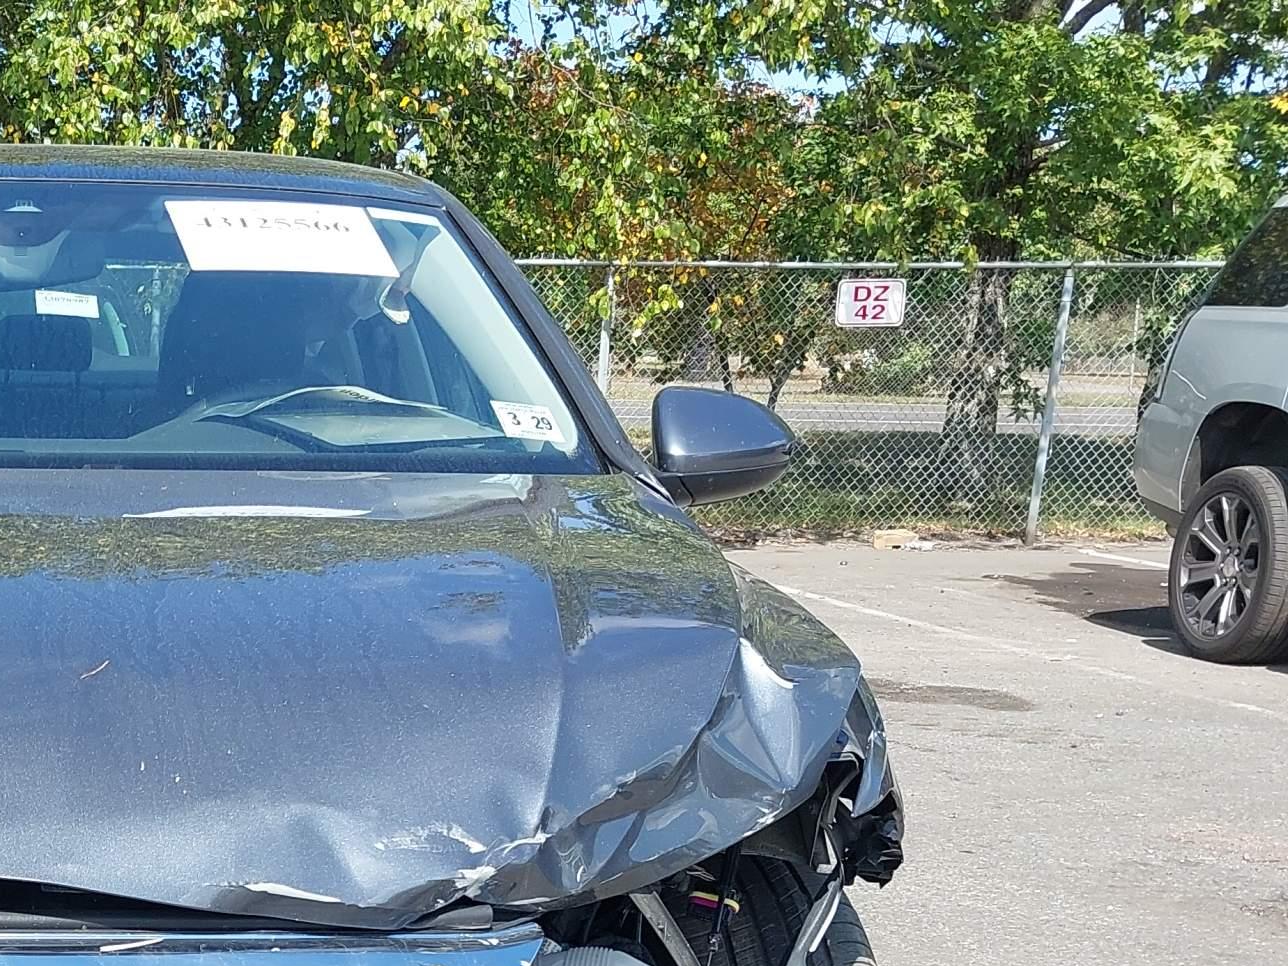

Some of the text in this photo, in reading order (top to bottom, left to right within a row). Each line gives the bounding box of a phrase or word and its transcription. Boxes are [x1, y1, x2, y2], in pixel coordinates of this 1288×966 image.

[853, 285, 890, 302] DZ
[854, 304, 886, 320] 42
[506, 411, 553, 431] 3 29
